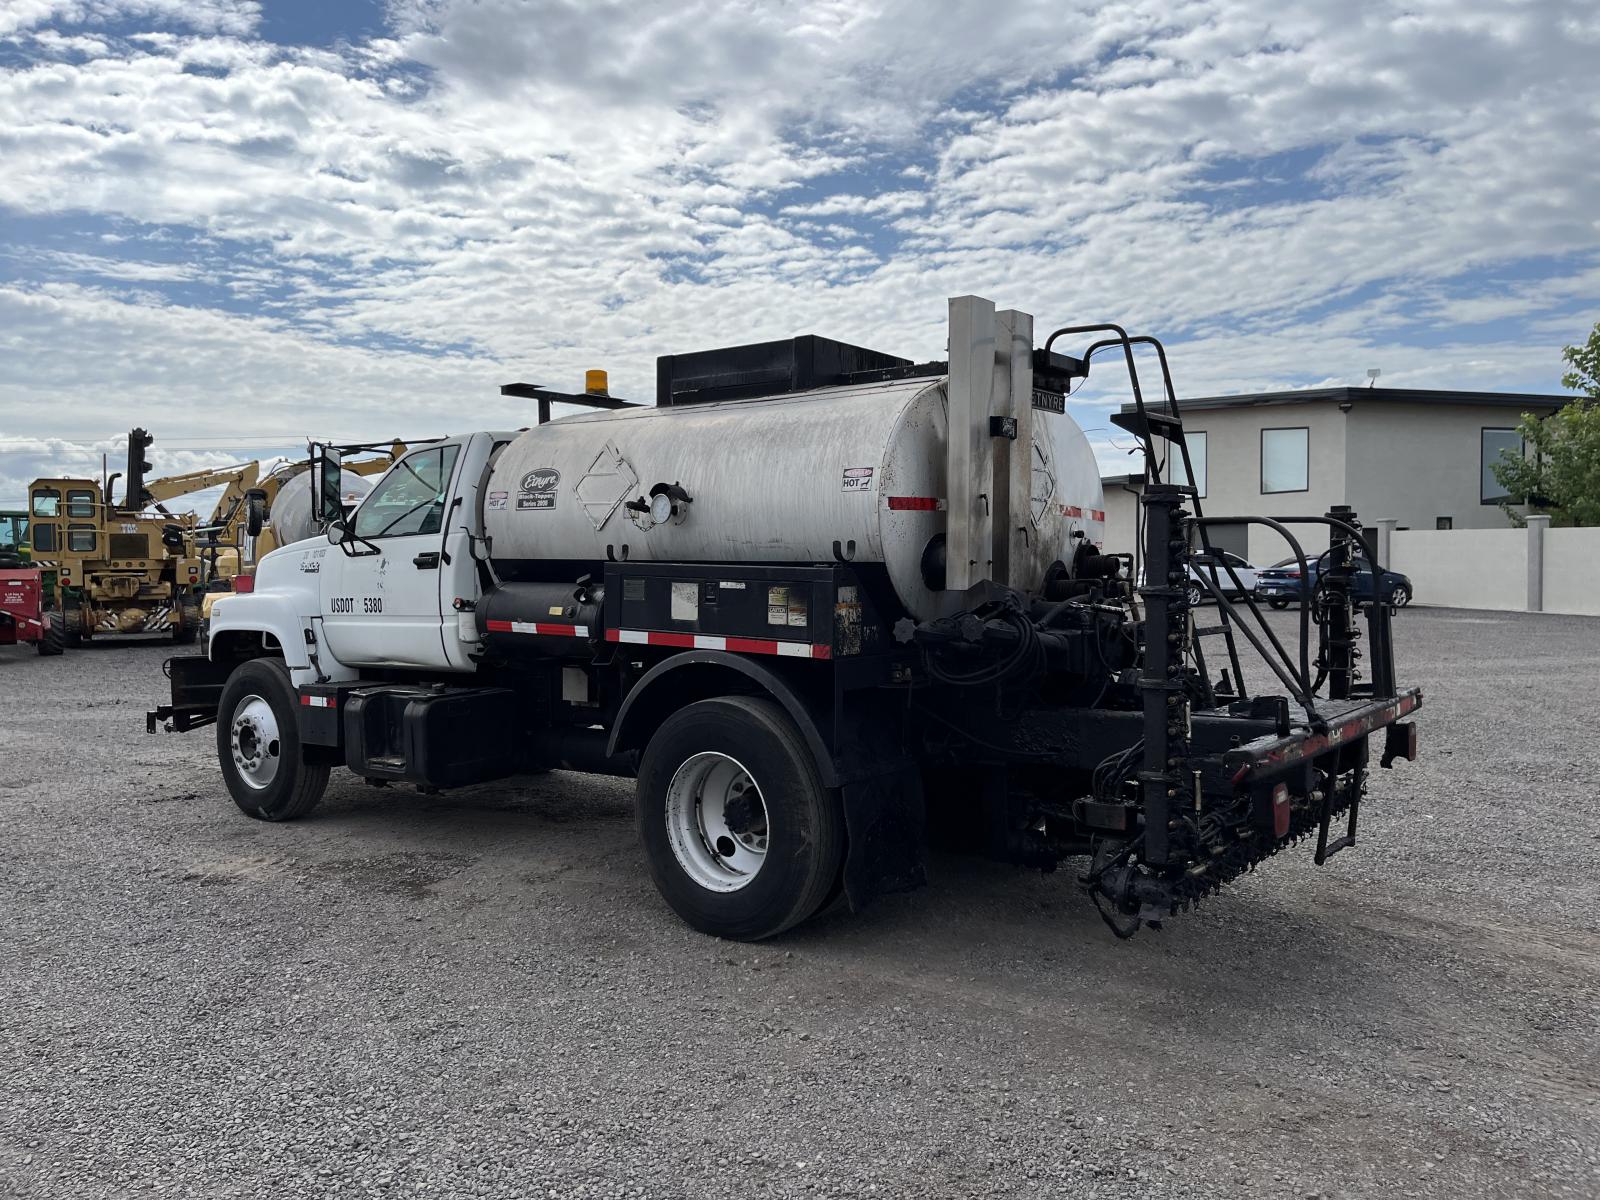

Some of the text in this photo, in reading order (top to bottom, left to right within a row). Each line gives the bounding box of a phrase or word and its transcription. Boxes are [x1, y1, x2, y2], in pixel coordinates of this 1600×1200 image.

[524, 474, 556, 489] Etnyre
[843, 478, 860, 487] HOT
[331, 598, 383, 613] USDOT 5380
